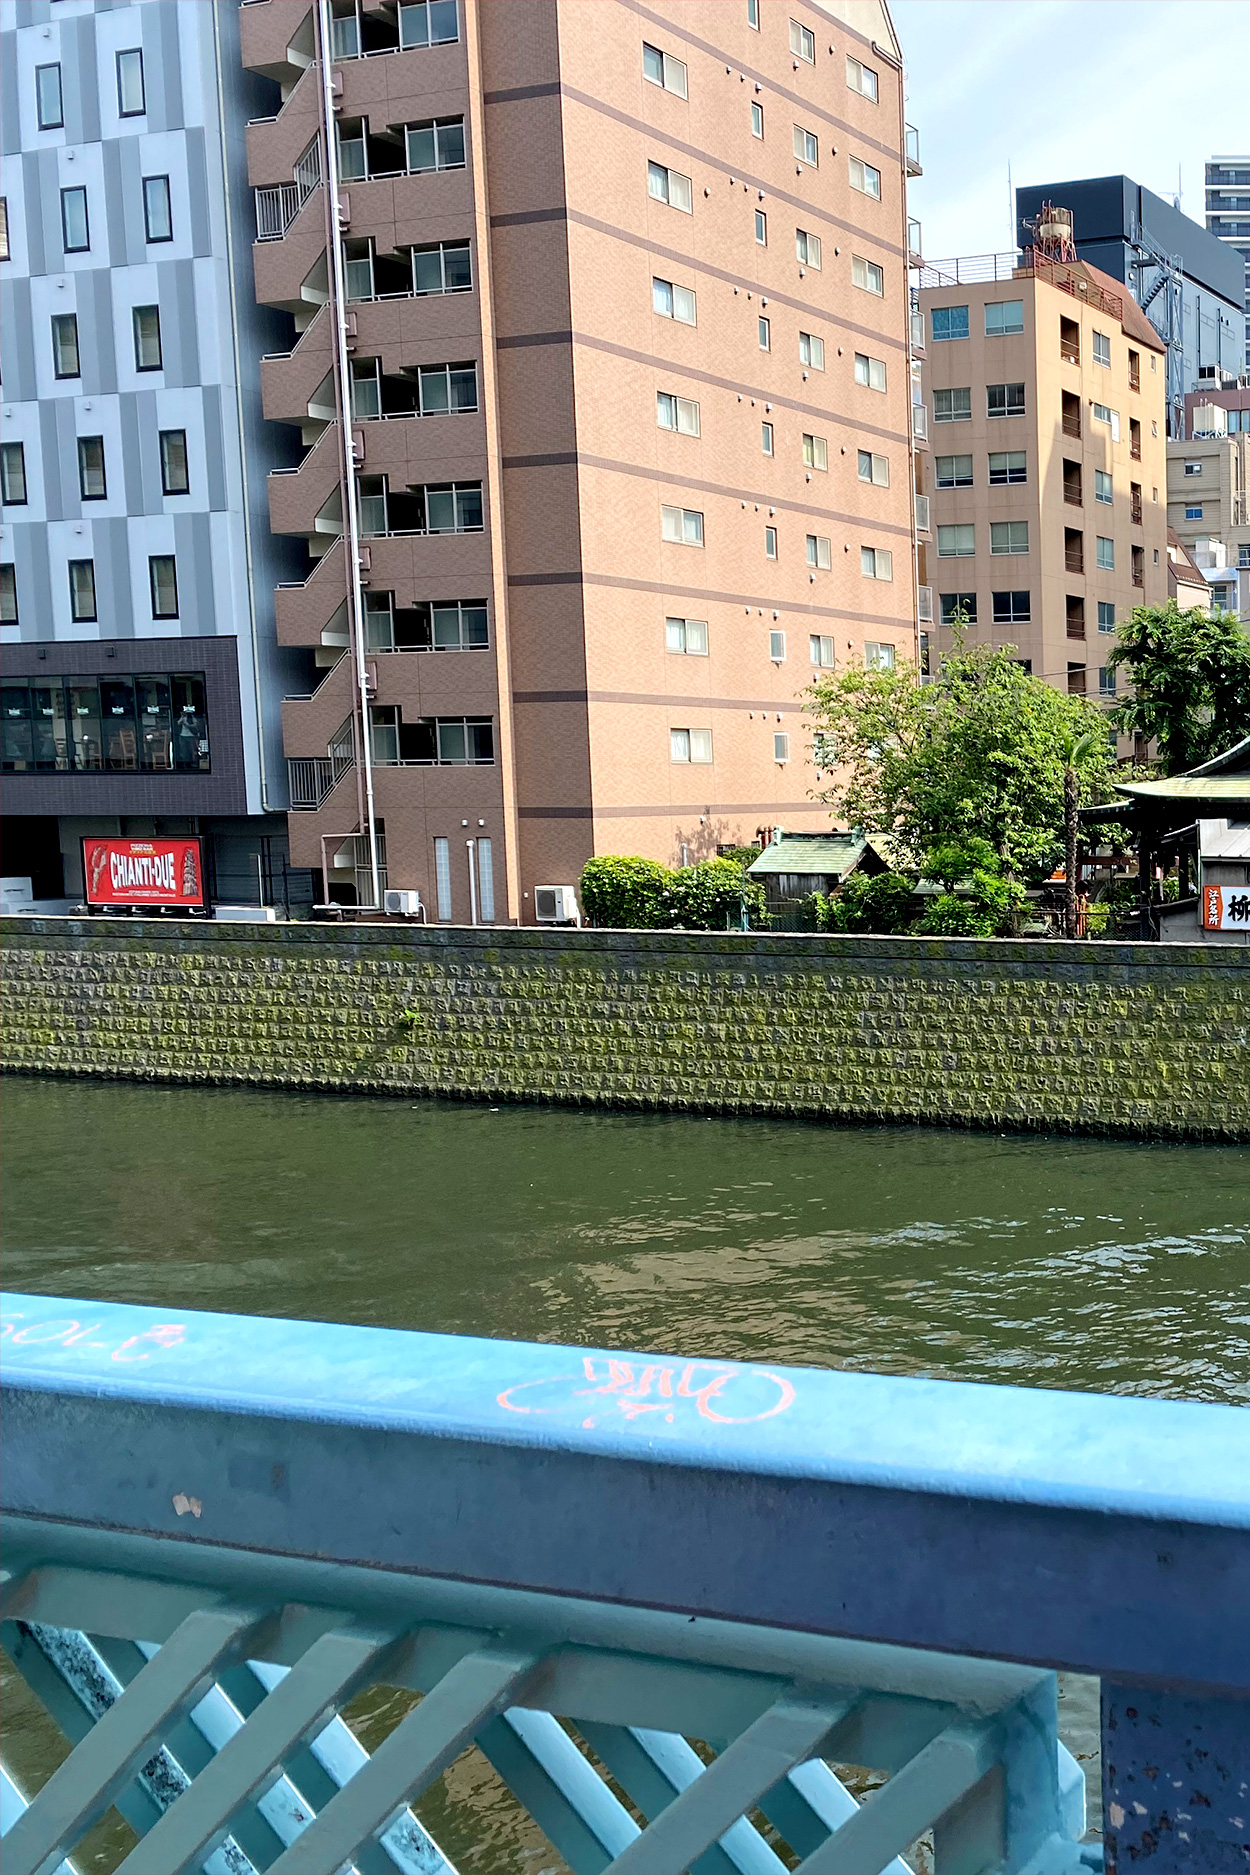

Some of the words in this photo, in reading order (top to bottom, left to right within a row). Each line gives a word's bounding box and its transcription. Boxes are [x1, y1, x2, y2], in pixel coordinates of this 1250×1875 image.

[110, 851, 177, 890] CHIANTI-DUE
[1208, 889, 1221, 926] 江戸名所
